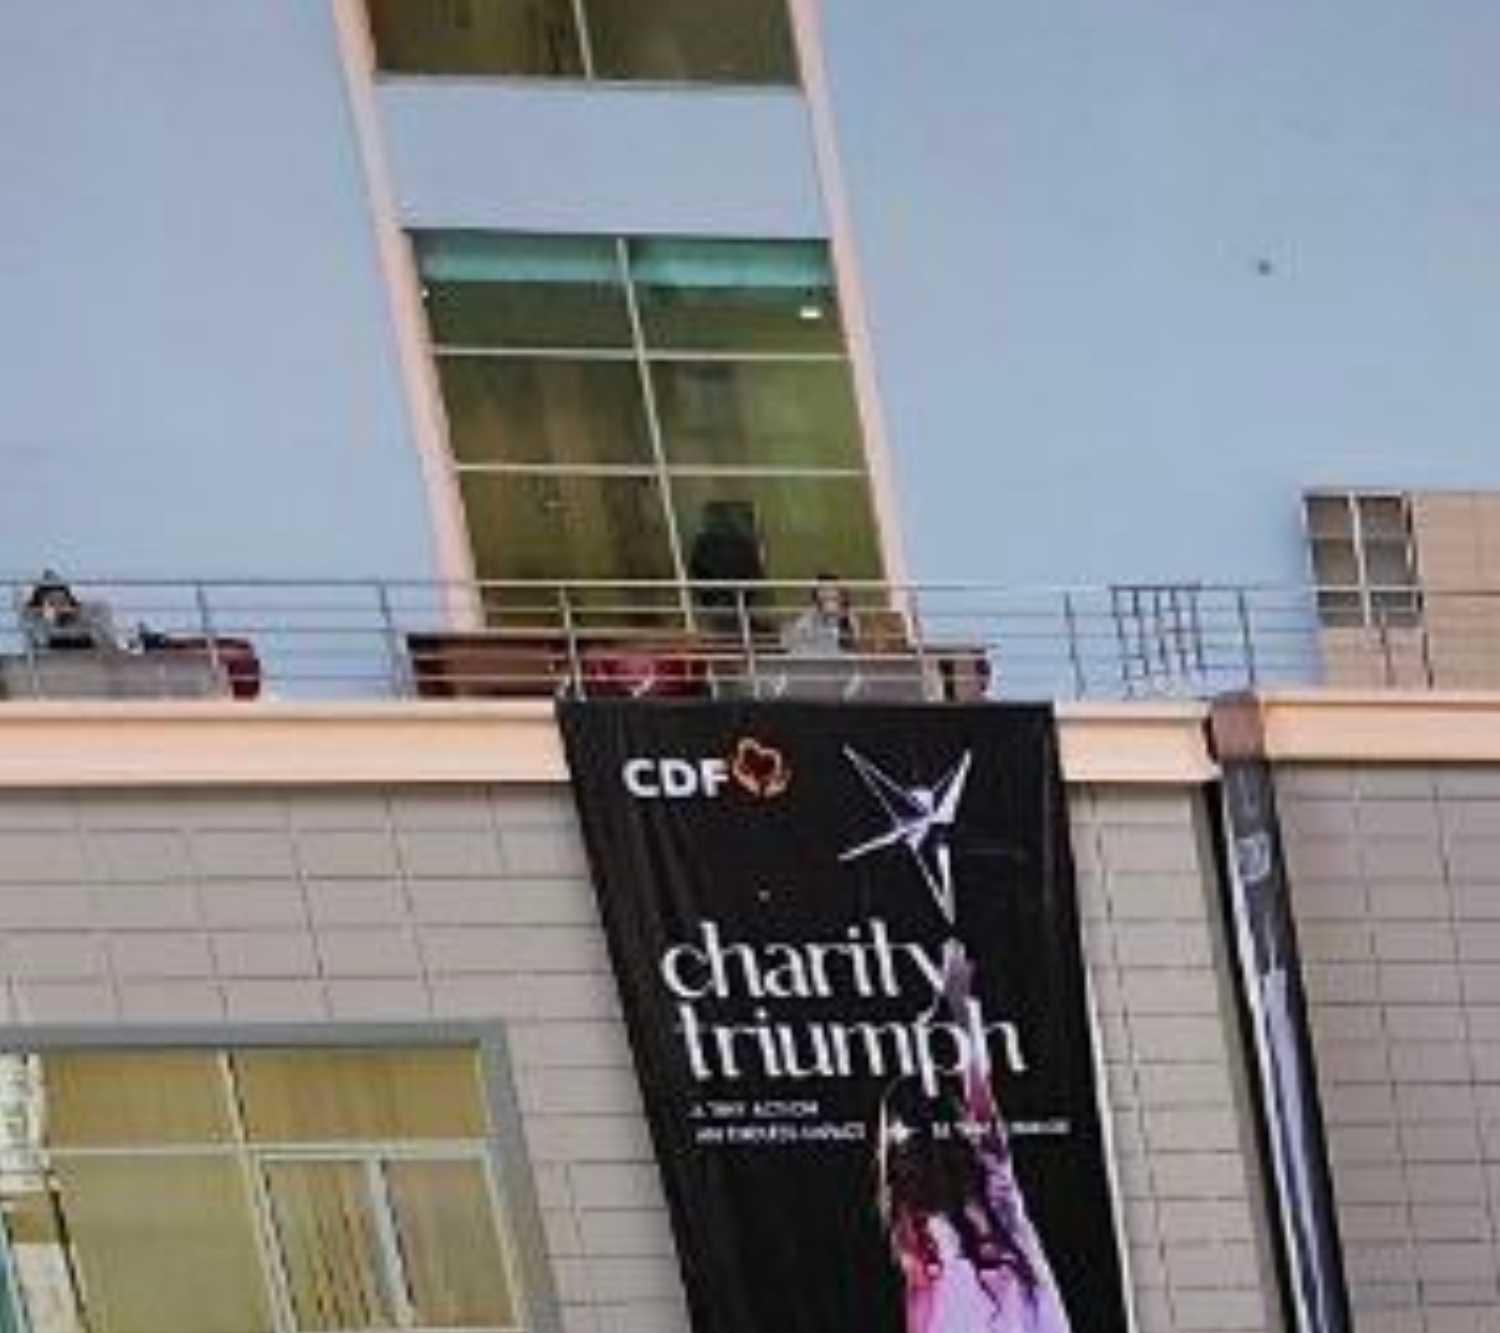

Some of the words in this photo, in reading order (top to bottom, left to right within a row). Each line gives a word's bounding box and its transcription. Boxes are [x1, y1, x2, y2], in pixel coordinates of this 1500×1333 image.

[622, 757, 730, 798] CDF
[661, 918, 946, 1025] charity
[676, 997, 1028, 1098] triumph
